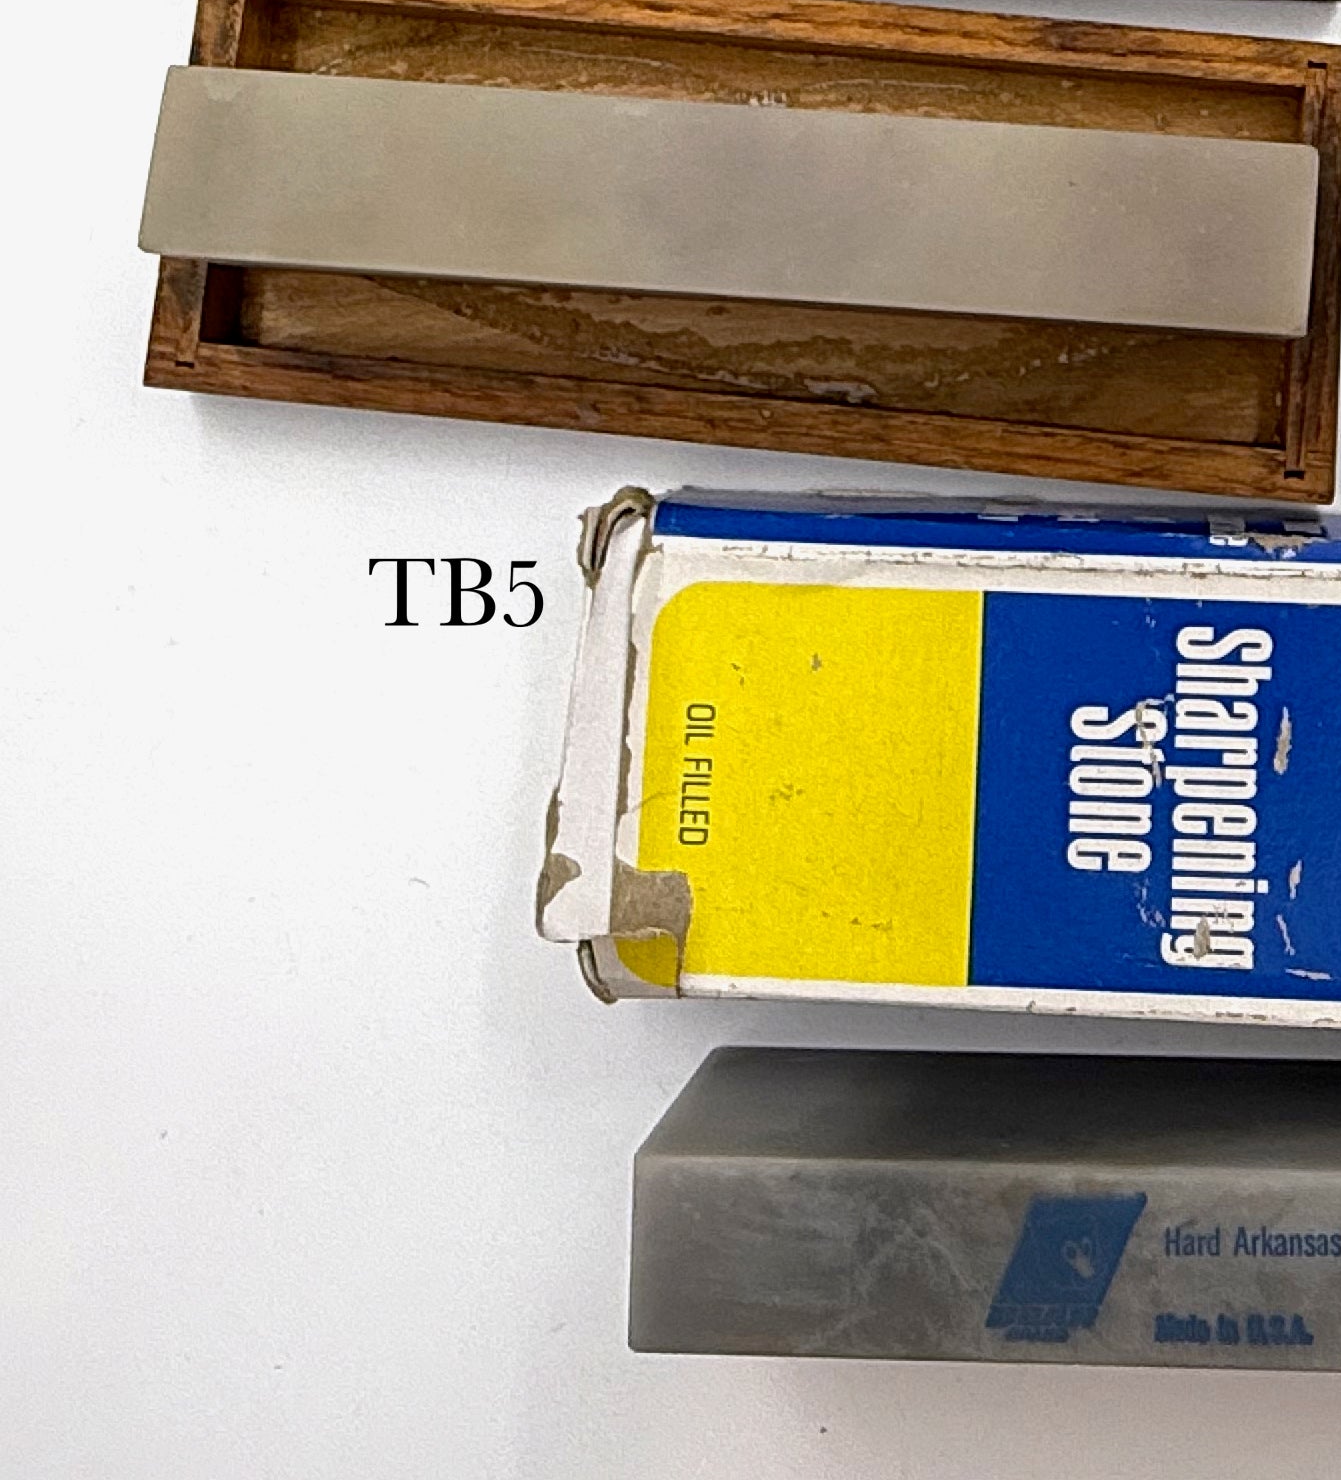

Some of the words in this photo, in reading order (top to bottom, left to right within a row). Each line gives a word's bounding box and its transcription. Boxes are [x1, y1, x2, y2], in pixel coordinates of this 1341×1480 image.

[685, 703, 717, 746] OIL
[679, 756, 713, 846] FILLED
[1067, 706, 1168, 873] Stone
[1160, 626, 1273, 970] Sharpening
[1164, 1226, 1222, 1258] Hard
